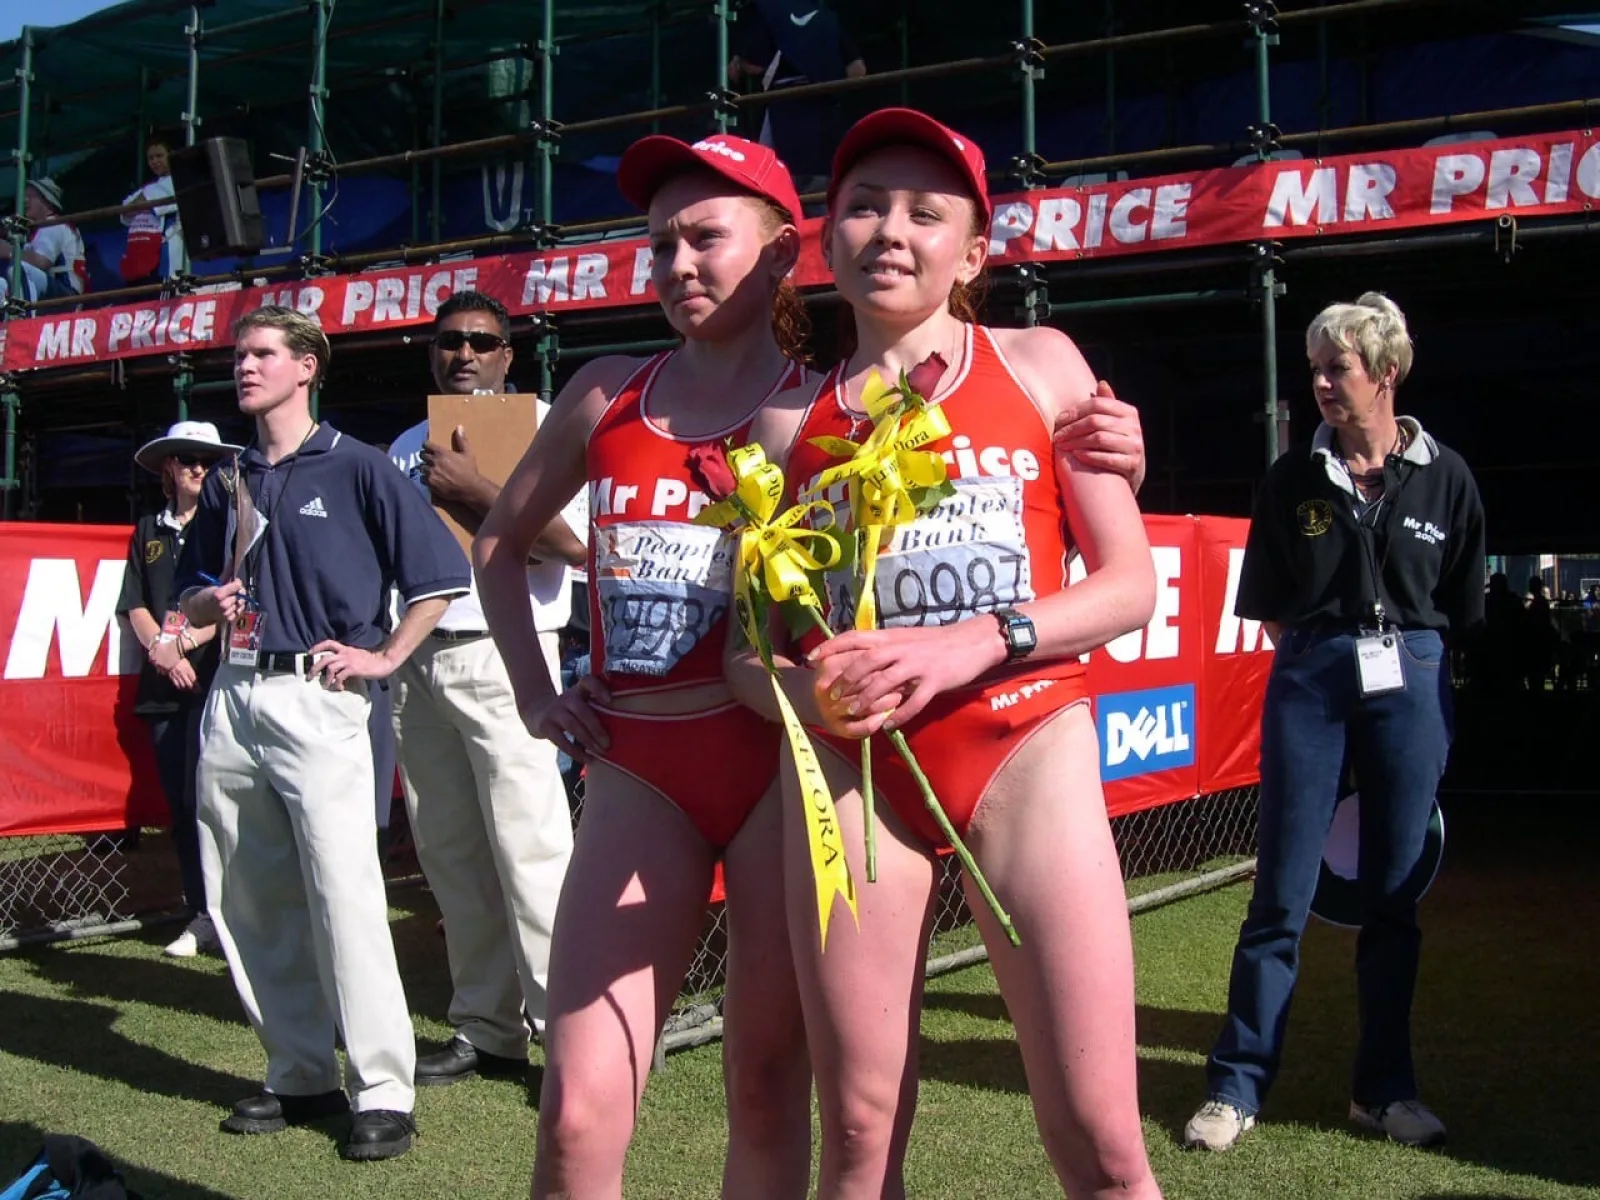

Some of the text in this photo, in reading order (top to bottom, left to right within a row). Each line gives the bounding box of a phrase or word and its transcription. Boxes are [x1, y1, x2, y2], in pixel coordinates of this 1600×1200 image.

[1262, 163, 1396, 228] MR
[988, 183, 1192, 256] PRICE
[520, 253, 609, 306] MR
[35, 318, 97, 361] MR
[108, 300, 217, 352] PRICE
[589, 477, 640, 519] Mr
[901, 523, 985, 551] Bank
[1403, 516, 1422, 530] Mr
[636, 559, 711, 583] Bank
[990, 693, 1020, 711] Mr
[1106, 701, 1190, 766] DELL
